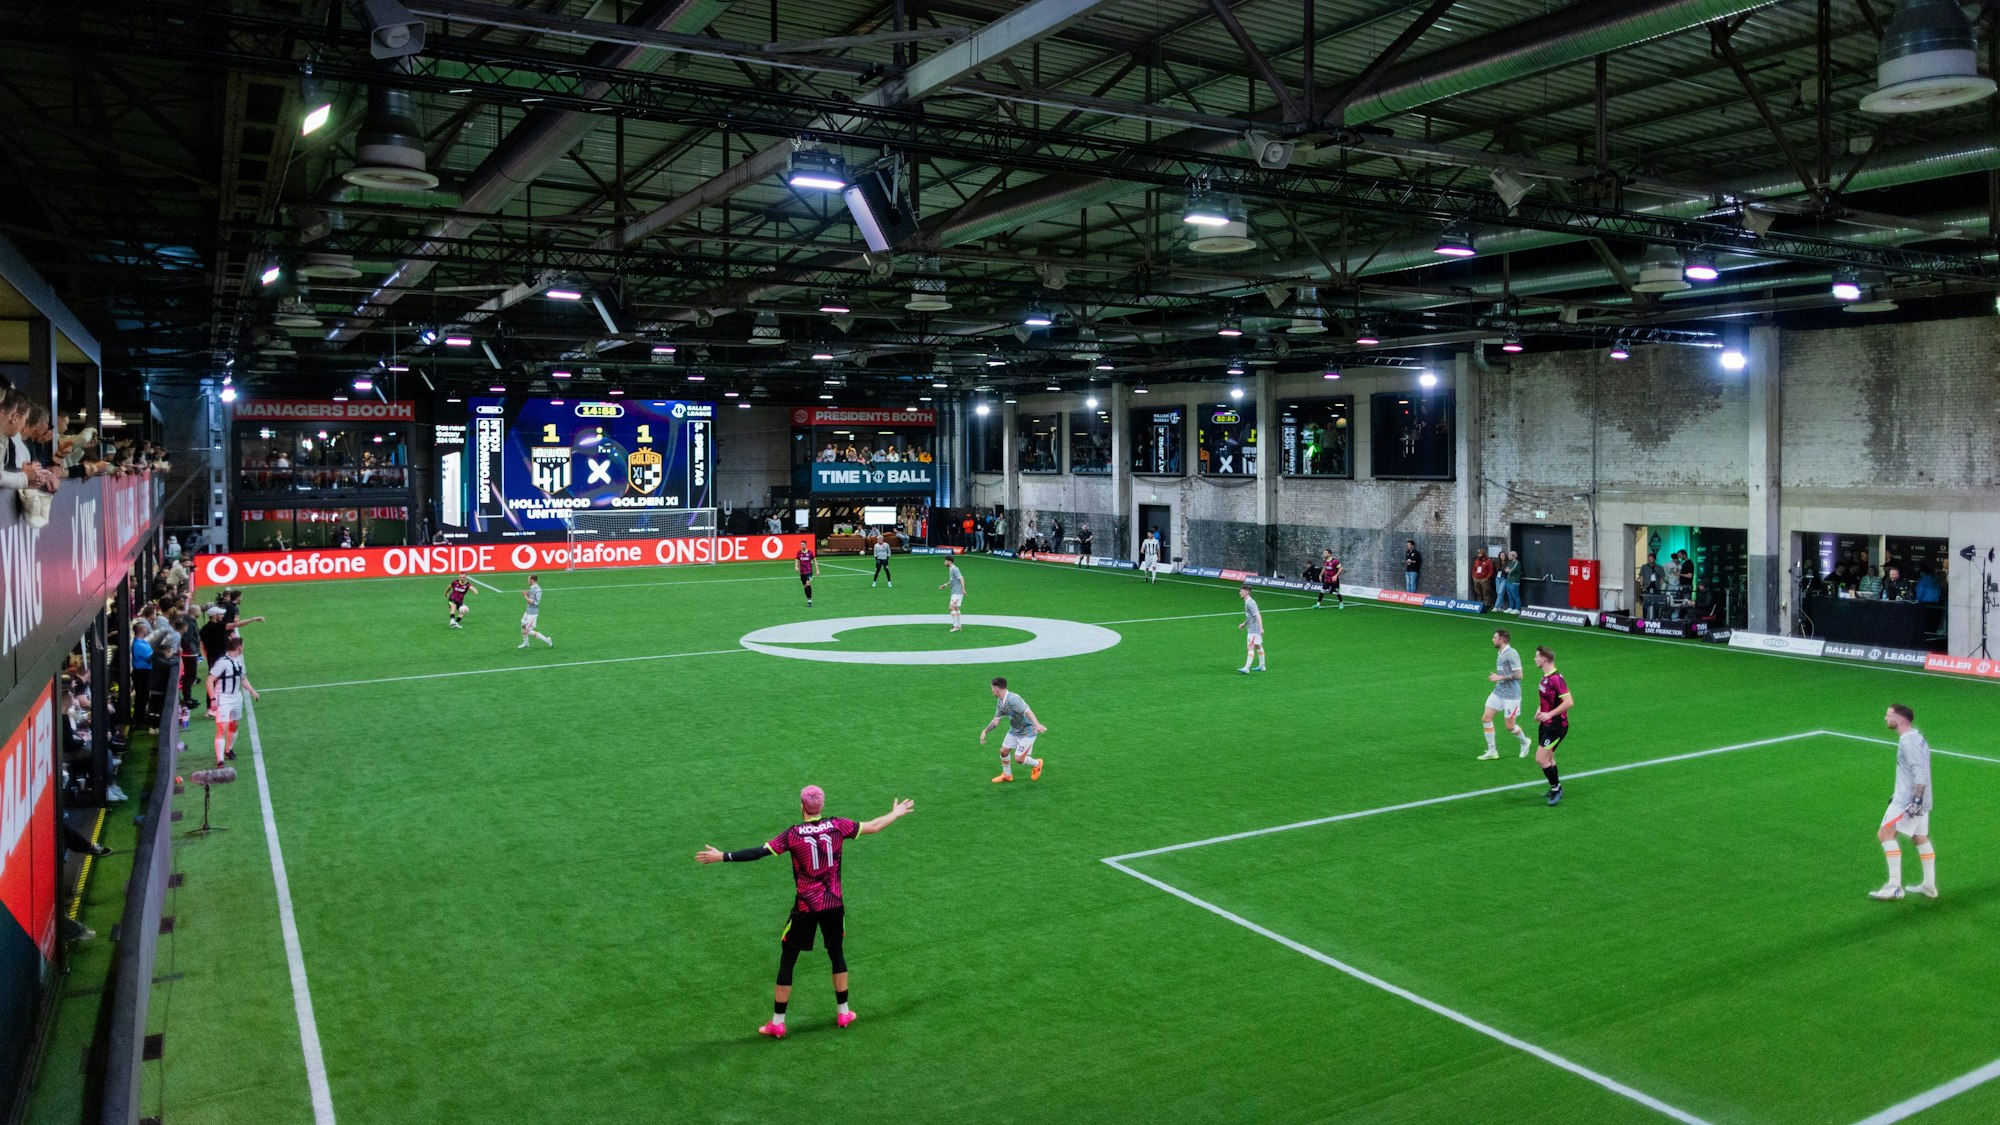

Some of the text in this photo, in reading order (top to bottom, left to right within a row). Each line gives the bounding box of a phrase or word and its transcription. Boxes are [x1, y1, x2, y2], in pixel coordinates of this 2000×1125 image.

[236, 403, 412, 417] MANAGERS BOOTH
[815, 411, 933, 422] PRESIDENTS BOOTH
[543, 424, 560, 443] 1
[636, 424, 653, 443] 1
[479, 420, 490, 504] MOTORWORLD
[694, 433, 704, 486] SPIELTAG
[818, 470, 860, 484] TIME
[887, 470, 930, 483] BALL
[508, 498, 591, 509] HOLLYWOOD
[611, 496, 679, 507] GOLDEN XI
[526, 509, 573, 519] UNITED
[541, 537, 748, 564] vodafone ONSIDE
[243, 546, 495, 577] vodafone ONSIDE
[0, 523, 43, 656] XING
[1521, 610, 1584, 624] BALLER LEAGUE
[1606, 615, 1616, 623] TVN
[1656, 628, 1683, 636] PRODUCTION
[1825, 646, 1926, 663] BALLER LEAGUE
[1928, 658, 1971, 670] BALLER
[0, 697, 52, 880] ALLER
[804, 834, 833, 870] 11
